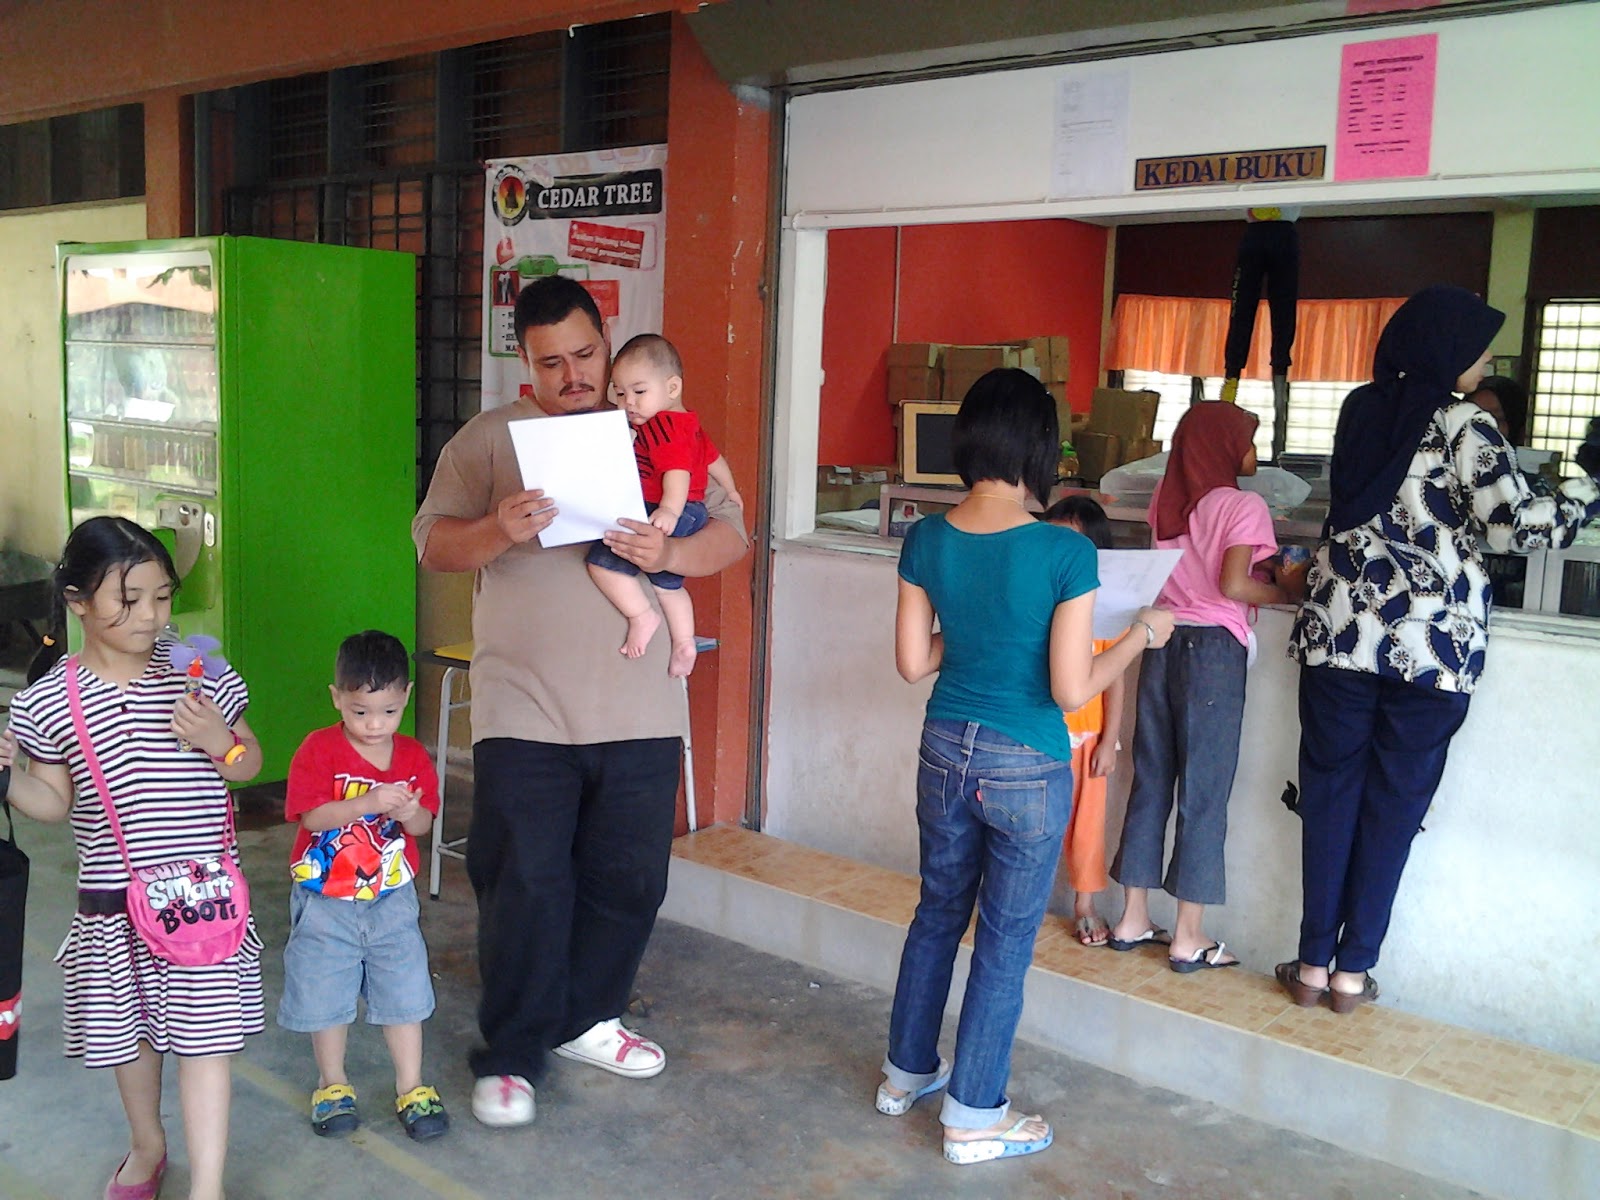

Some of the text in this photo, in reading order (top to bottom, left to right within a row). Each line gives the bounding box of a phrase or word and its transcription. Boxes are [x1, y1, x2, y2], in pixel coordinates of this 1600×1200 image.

[1144, 152, 1316, 186] KEDAI BUKU
[538, 181, 653, 209] CEDAR TREE
